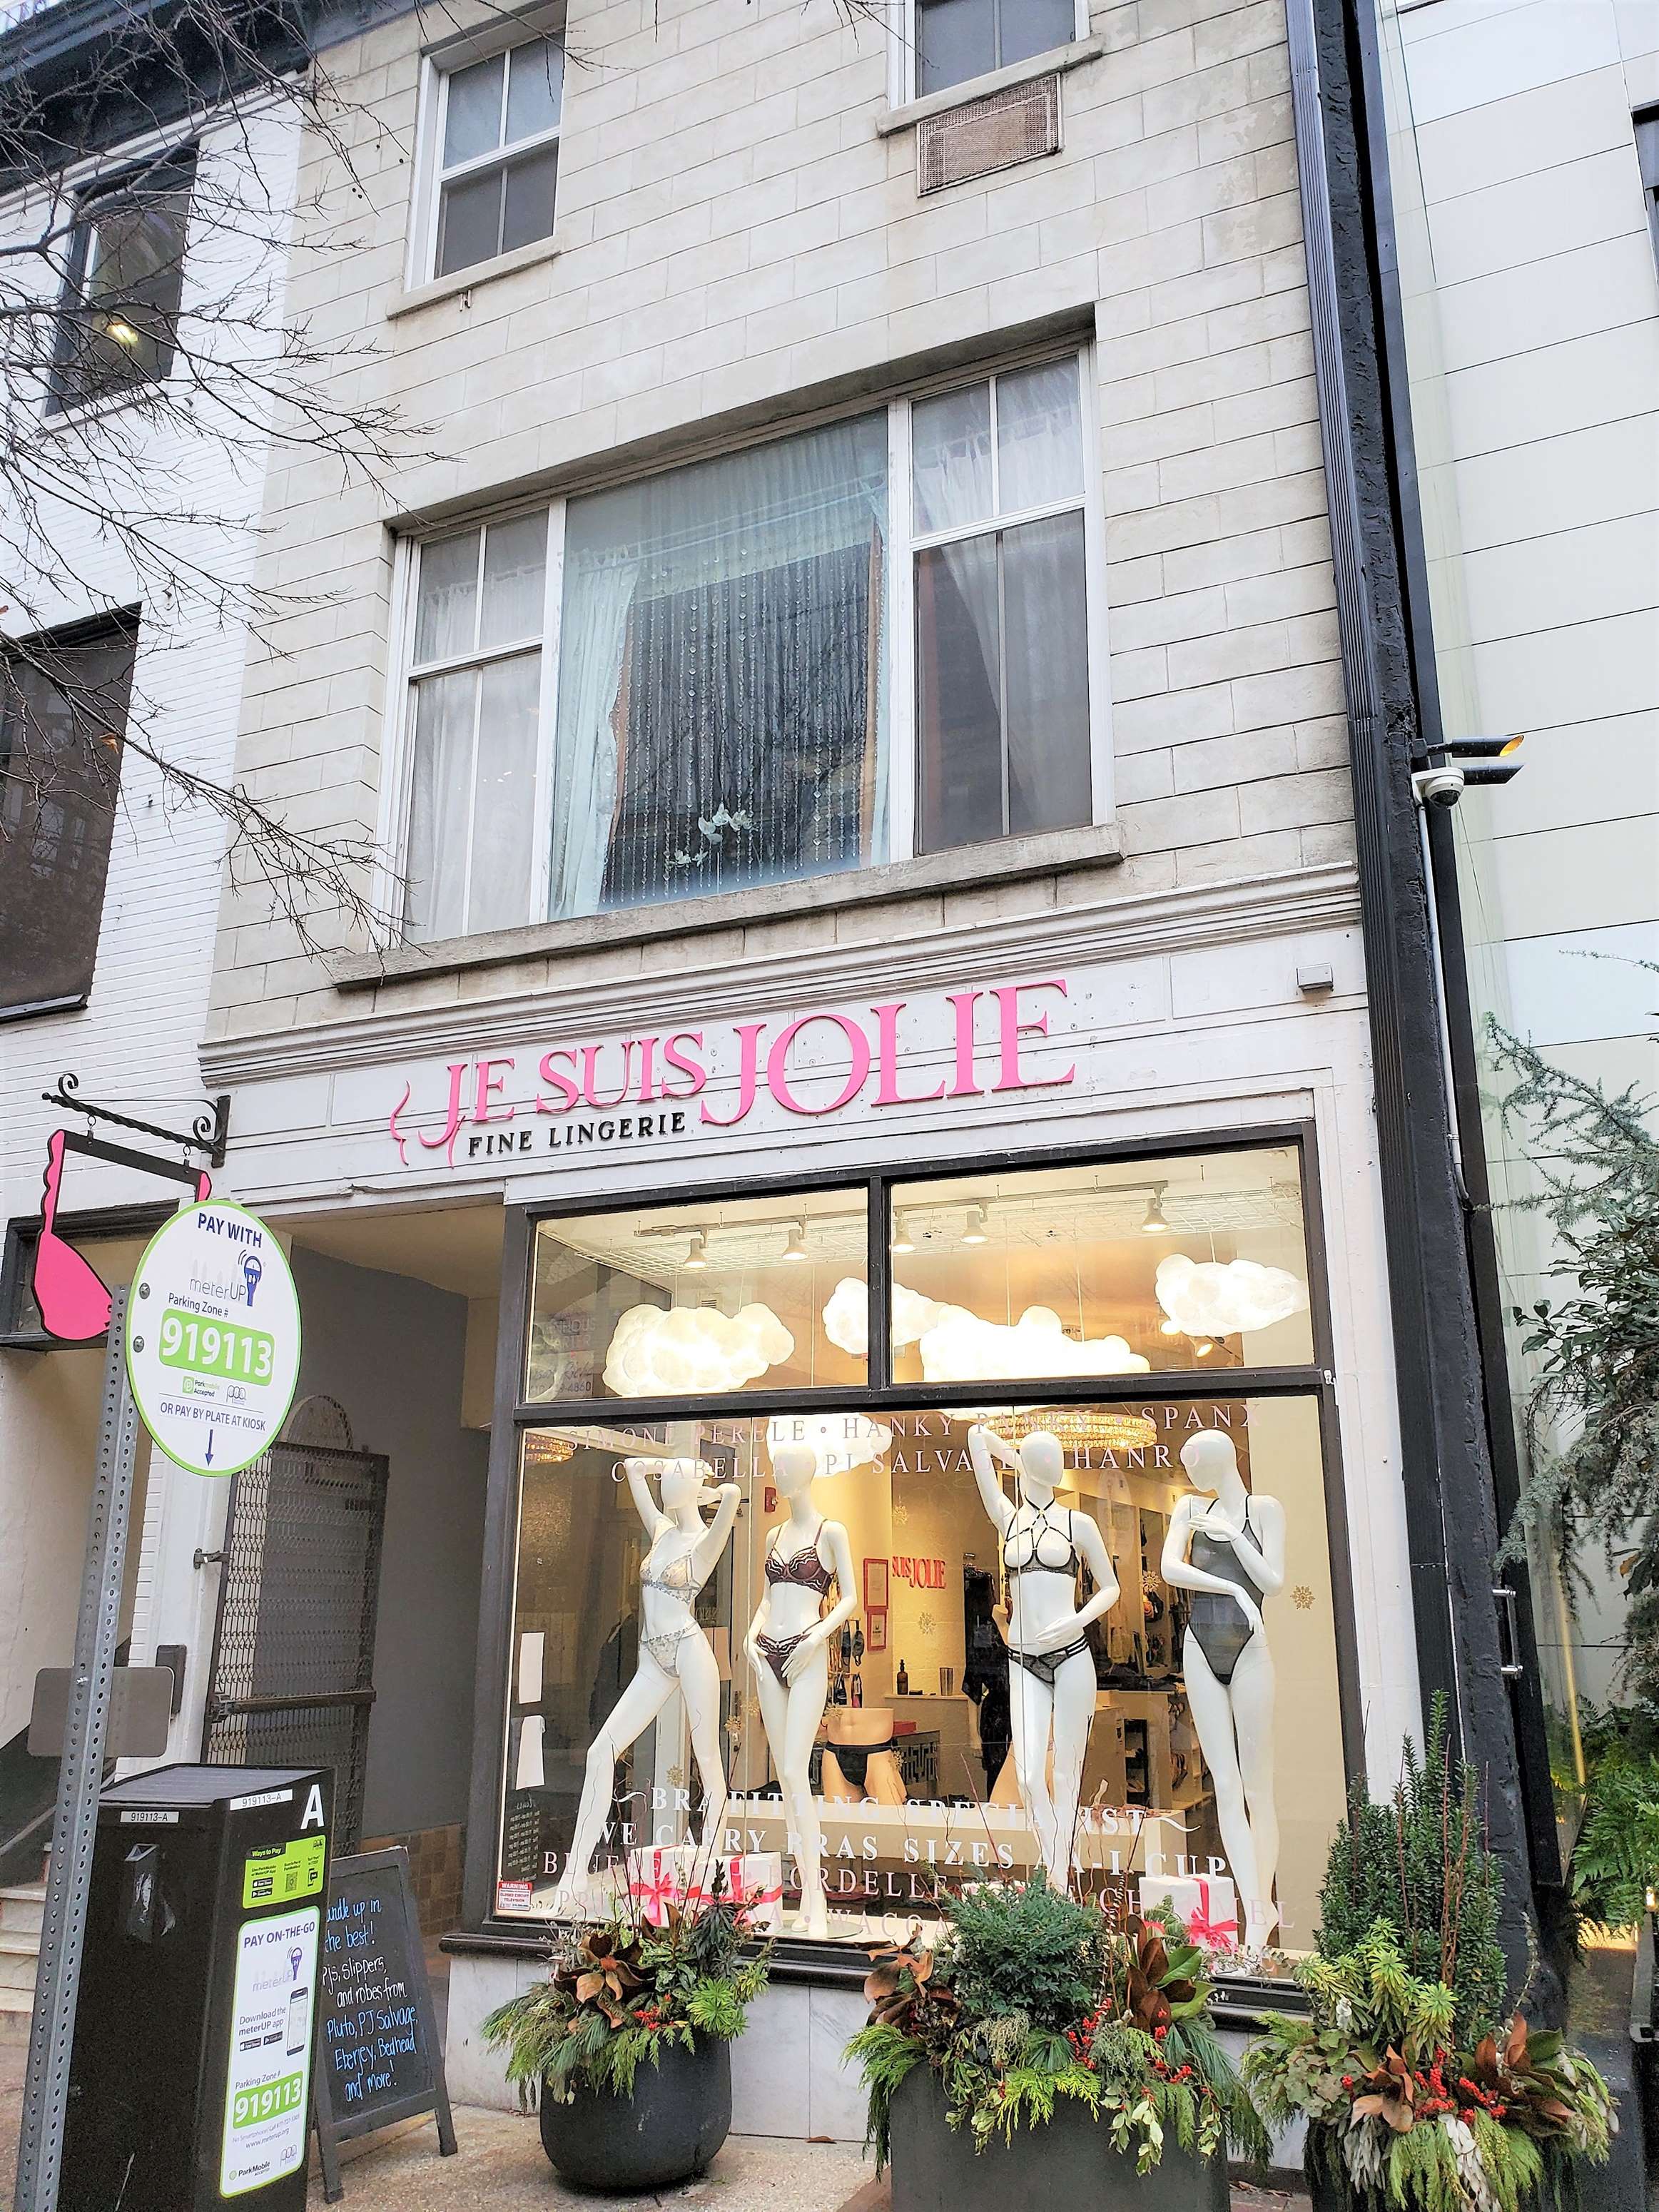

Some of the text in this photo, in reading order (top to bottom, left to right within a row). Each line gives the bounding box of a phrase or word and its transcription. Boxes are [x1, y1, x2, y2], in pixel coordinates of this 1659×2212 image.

[417, 979, 1075, 1148] JE SUIS JOLIE
[467, 1112, 686, 1157] FINE LINGERIE
[198, 1212, 263, 1249] PAY WITH
[168, 1292, 201, 1313] Parking
[201, 1301, 223, 1316] Zone
[189, 1278, 246, 1301] meterUP
[162, 1317, 273, 1379] 919113
[193, 1388, 215, 1398] Accepted
[160, 1401, 266, 1431] OR PAY BY PLATE AT KIOSK
[567, 1426, 675, 1451] SIMONE
[842, 1414, 955, 1439] HANKY
[1142, 1404, 1262, 1431] SPANX
[612, 1453, 788, 1483] COSABELLA
[1070, 1444, 1200, 1470] HANRO
[909, 1558, 946, 1589] JOLIE
[131, 1812, 168, 1822] 919113-A
[242, 1784, 325, 1830] 919113-A A
[650, 1787, 712, 1812] BRA
[728, 1790, 880, 1819] FITTING
[597, 1822, 637, 1845] WE
[655, 1824, 767, 1854] CARRY
[786, 1832, 878, 1860] BRAS
[903, 1838, 1014, 1869] SIZES
[1145, 1852, 1228, 1884] CUP
[327, 1897, 382, 1924] undle up in
[243, 1921, 315, 1949] PAY ON-THE-GO
[325, 1920, 375, 1953] the best!
[342, 1956, 387, 1984] slippers,
[337, 1977, 408, 2008] and robes from
[238, 2018, 284, 2036] meterUP app
[239, 2006, 285, 2025] Download the
[327, 2005, 418, 2043] Pluto, PJ Salvage,
[377, 2034, 417, 2058] Bedhead
[235, 2076, 260, 2090] Parking
[262, 2072, 277, 2084] Zone
[345, 2072, 363, 2102] and
[235, 2077, 302, 2123] 919113
[238, 2161, 270, 2177] ParkMobile
